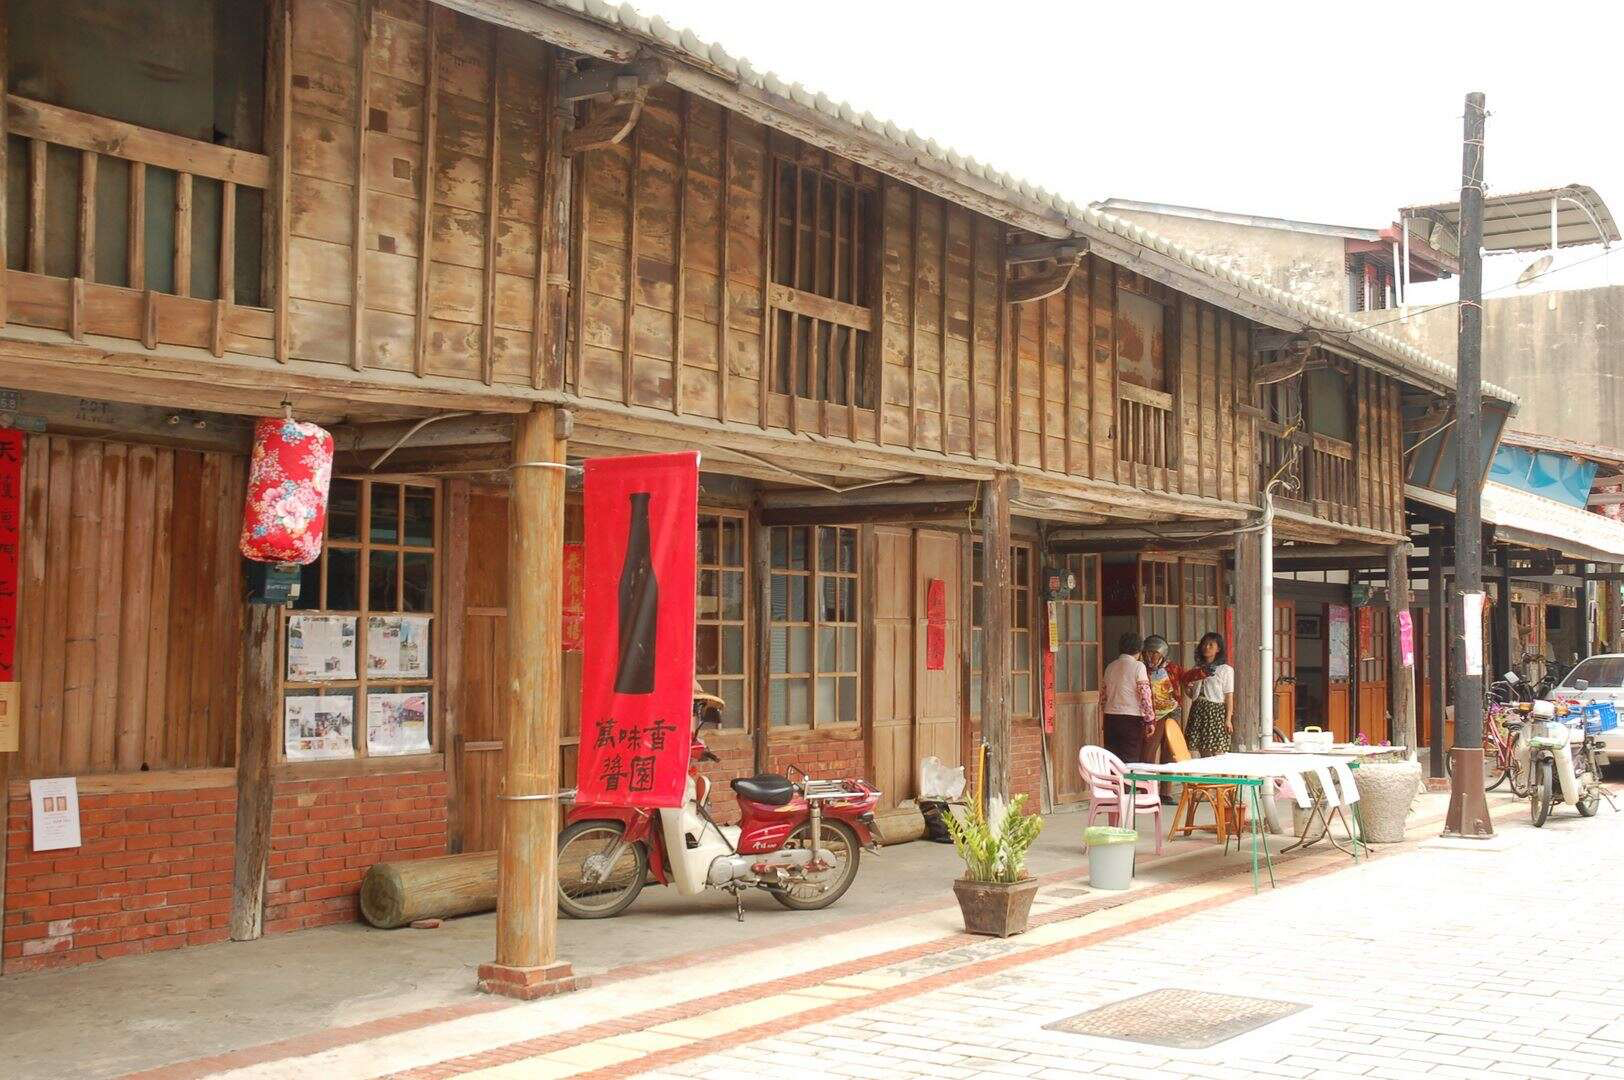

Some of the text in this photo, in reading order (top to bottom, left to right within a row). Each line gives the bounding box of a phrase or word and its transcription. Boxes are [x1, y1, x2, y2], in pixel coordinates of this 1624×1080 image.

[594, 716, 677, 751] 萬味香
[600, 753, 656, 792] 醬園
